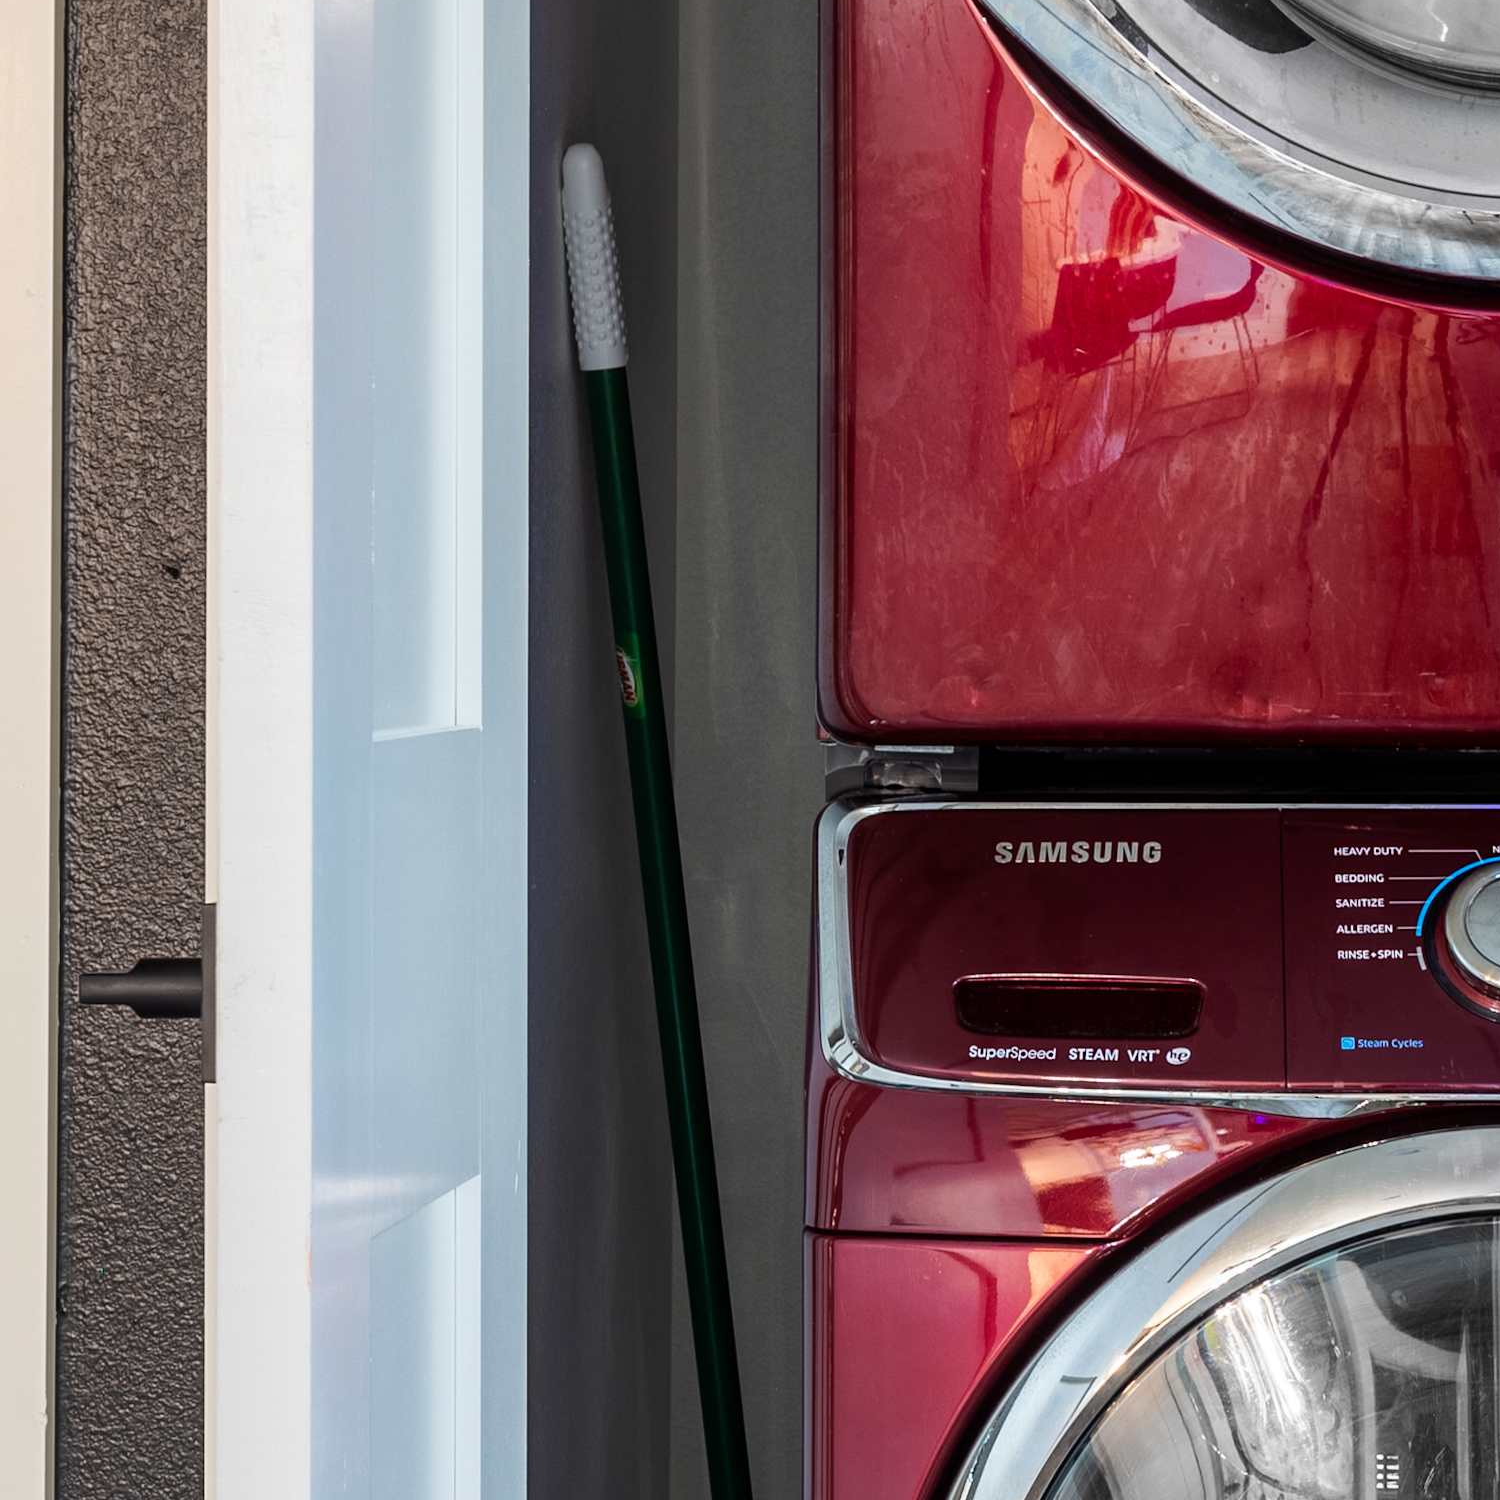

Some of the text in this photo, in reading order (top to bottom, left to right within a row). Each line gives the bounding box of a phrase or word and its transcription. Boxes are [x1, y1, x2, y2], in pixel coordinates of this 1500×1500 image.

[993, 840, 1162, 864] SAMSUNG
[1333, 846, 1403, 856] HEAVY DUTY
[1335, 873, 1385, 884] BEDDING
[1335, 898, 1385, 908] SANITIZE
[1336, 924, 1393, 934] ALLERGEN
[1358, 1038, 1425, 1050] Steam Cycles
[969, 1045, 1057, 1062] SuperSpeed
[1068, 1048, 1120, 1062] STEAM
